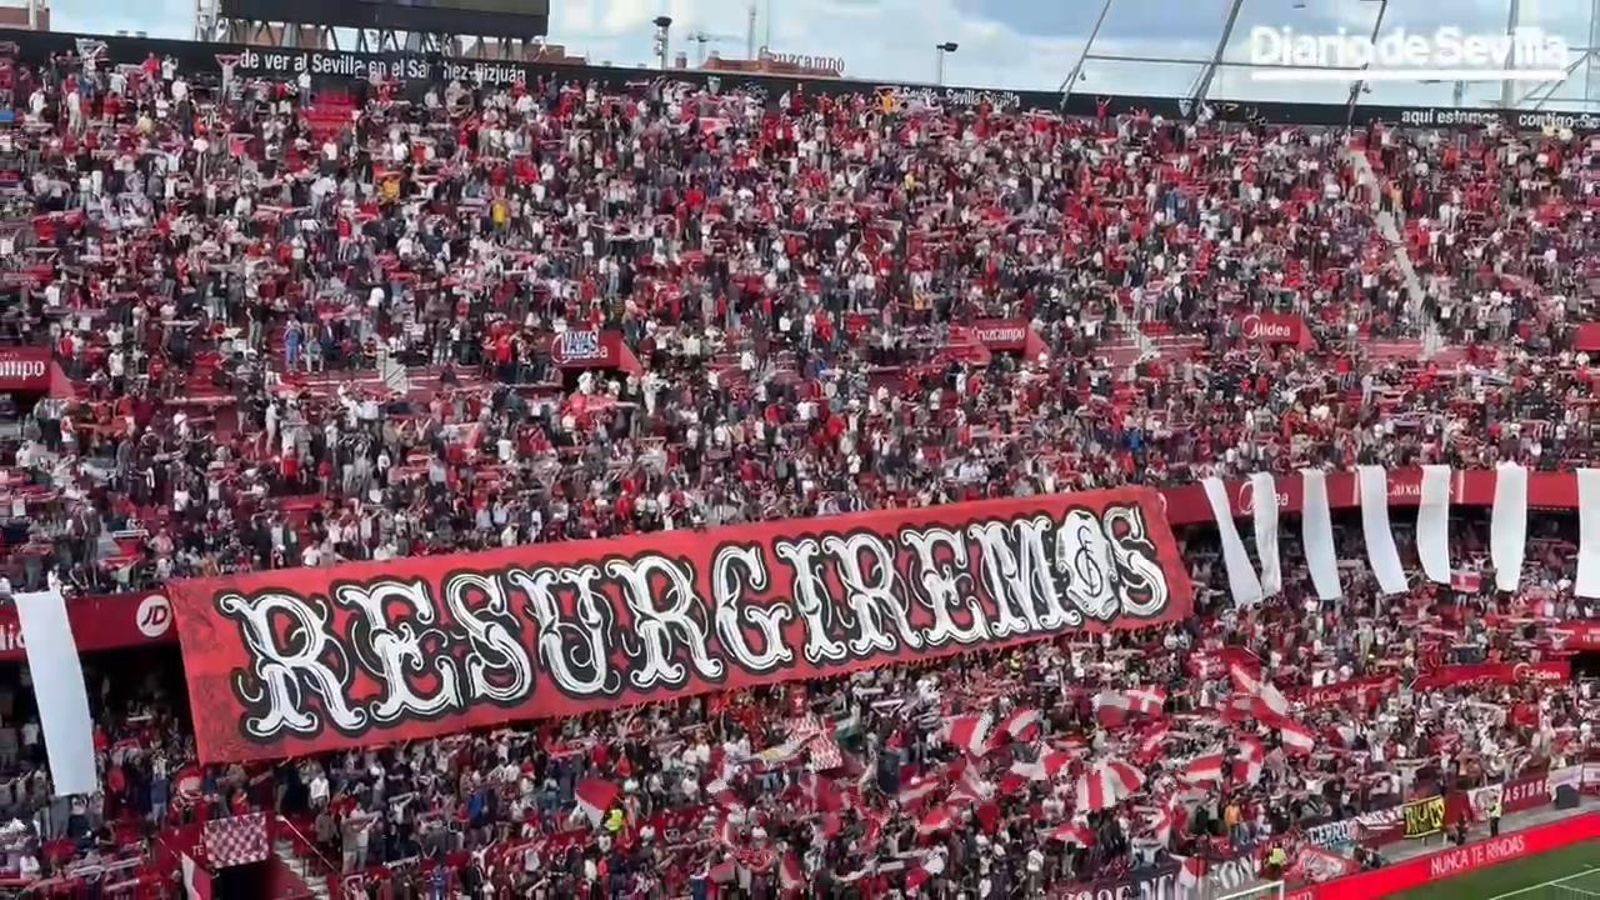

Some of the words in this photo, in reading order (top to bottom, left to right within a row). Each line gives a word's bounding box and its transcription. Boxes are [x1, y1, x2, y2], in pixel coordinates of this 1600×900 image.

[240, 48, 259, 69] de
[264, 53, 291, 71] ver
[294, 52, 307, 72] al
[312, 53, 364, 75] Sevilla
[391, 59, 404, 78] el
[1401, 108, 1434, 127] aquí
[141, 604, 168, 628] JD
[220, 505, 1170, 737] RESURGIREMOS
[1431, 850, 1470, 876] NUNCA
[1471, 844, 1485, 868] TE
